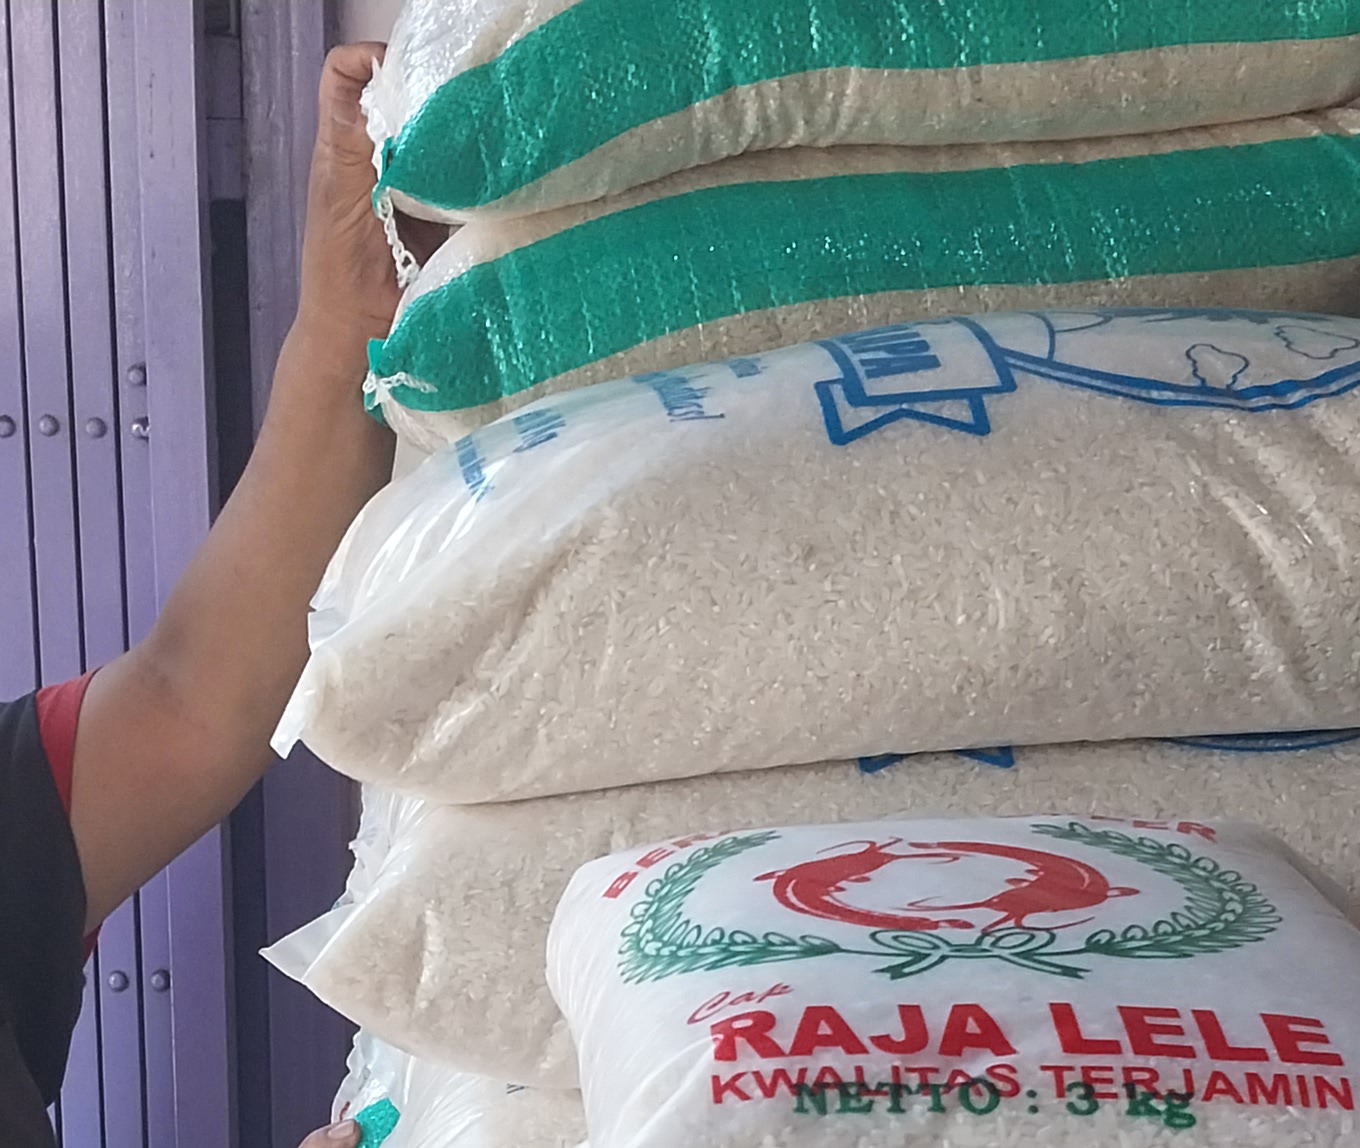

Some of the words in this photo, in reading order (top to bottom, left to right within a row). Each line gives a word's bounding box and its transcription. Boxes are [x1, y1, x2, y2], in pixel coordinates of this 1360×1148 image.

[686, 981, 793, 1025] Cap
[710, 1002, 1017, 1061] RAJA
[1048, 1002, 1345, 1068] LELE
[710, 1061, 1024, 1106] KWALITAS
[1040, 1064, 1356, 1112] TERJAMIN
[792, 1079, 1004, 1117] NETTO
[1125, 1088, 1198, 1130] kg
